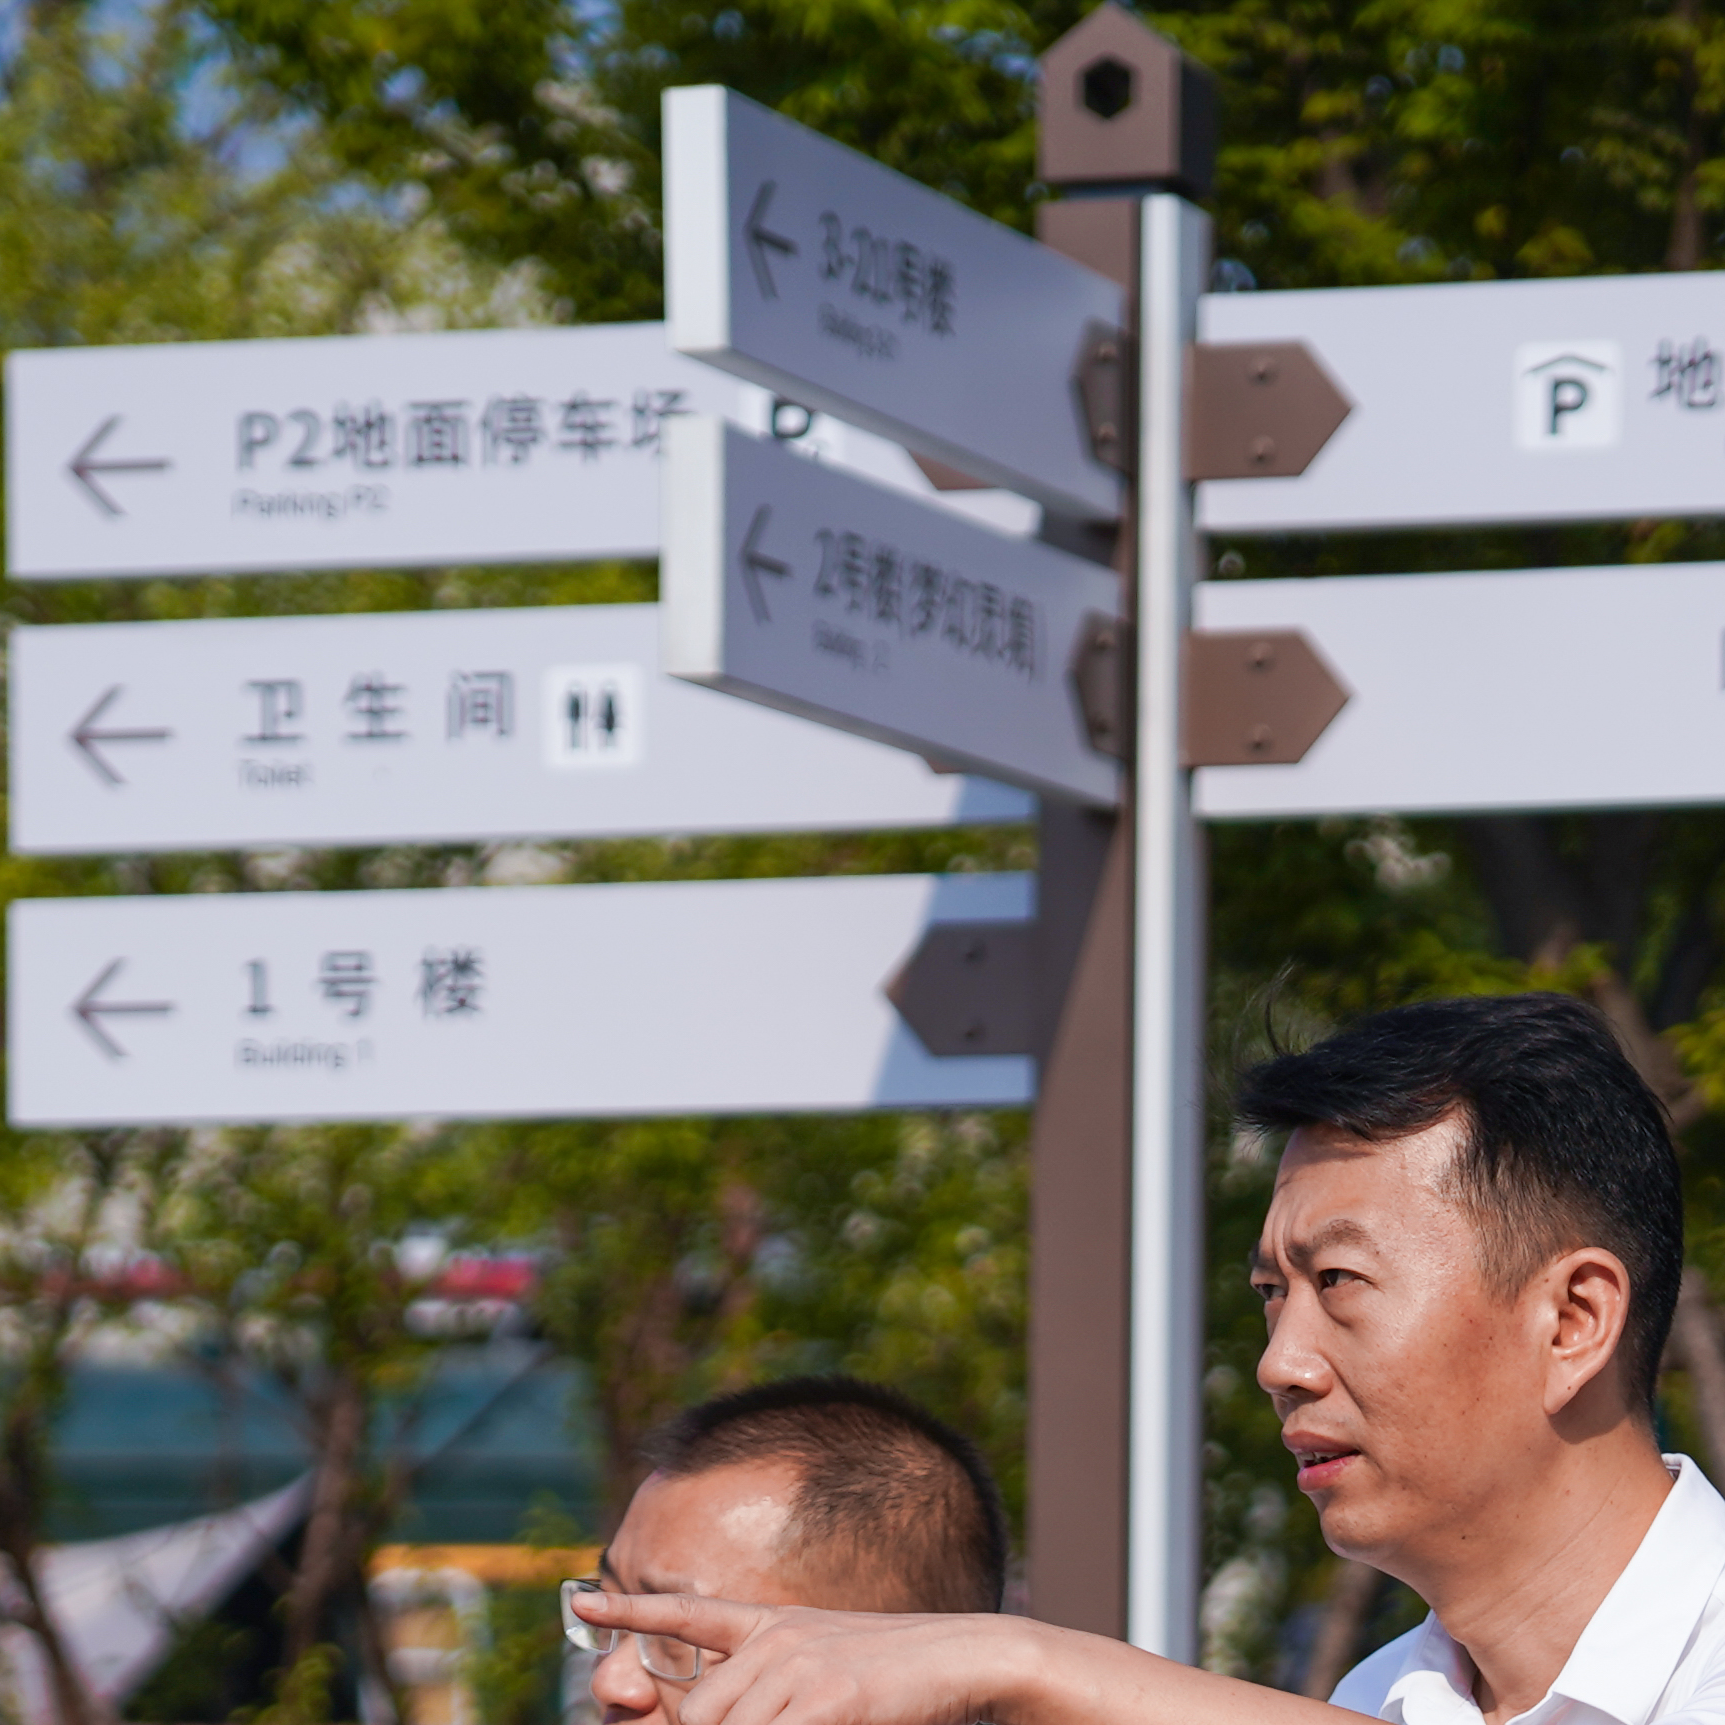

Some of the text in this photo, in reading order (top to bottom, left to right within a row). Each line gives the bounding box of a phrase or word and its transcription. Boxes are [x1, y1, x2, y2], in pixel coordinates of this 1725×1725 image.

[1548, 377, 1588, 435] P
[233, 488, 339, 521] Parking
[241, 669, 516, 745] 卫生间
[235, 1039, 349, 1071] Building
